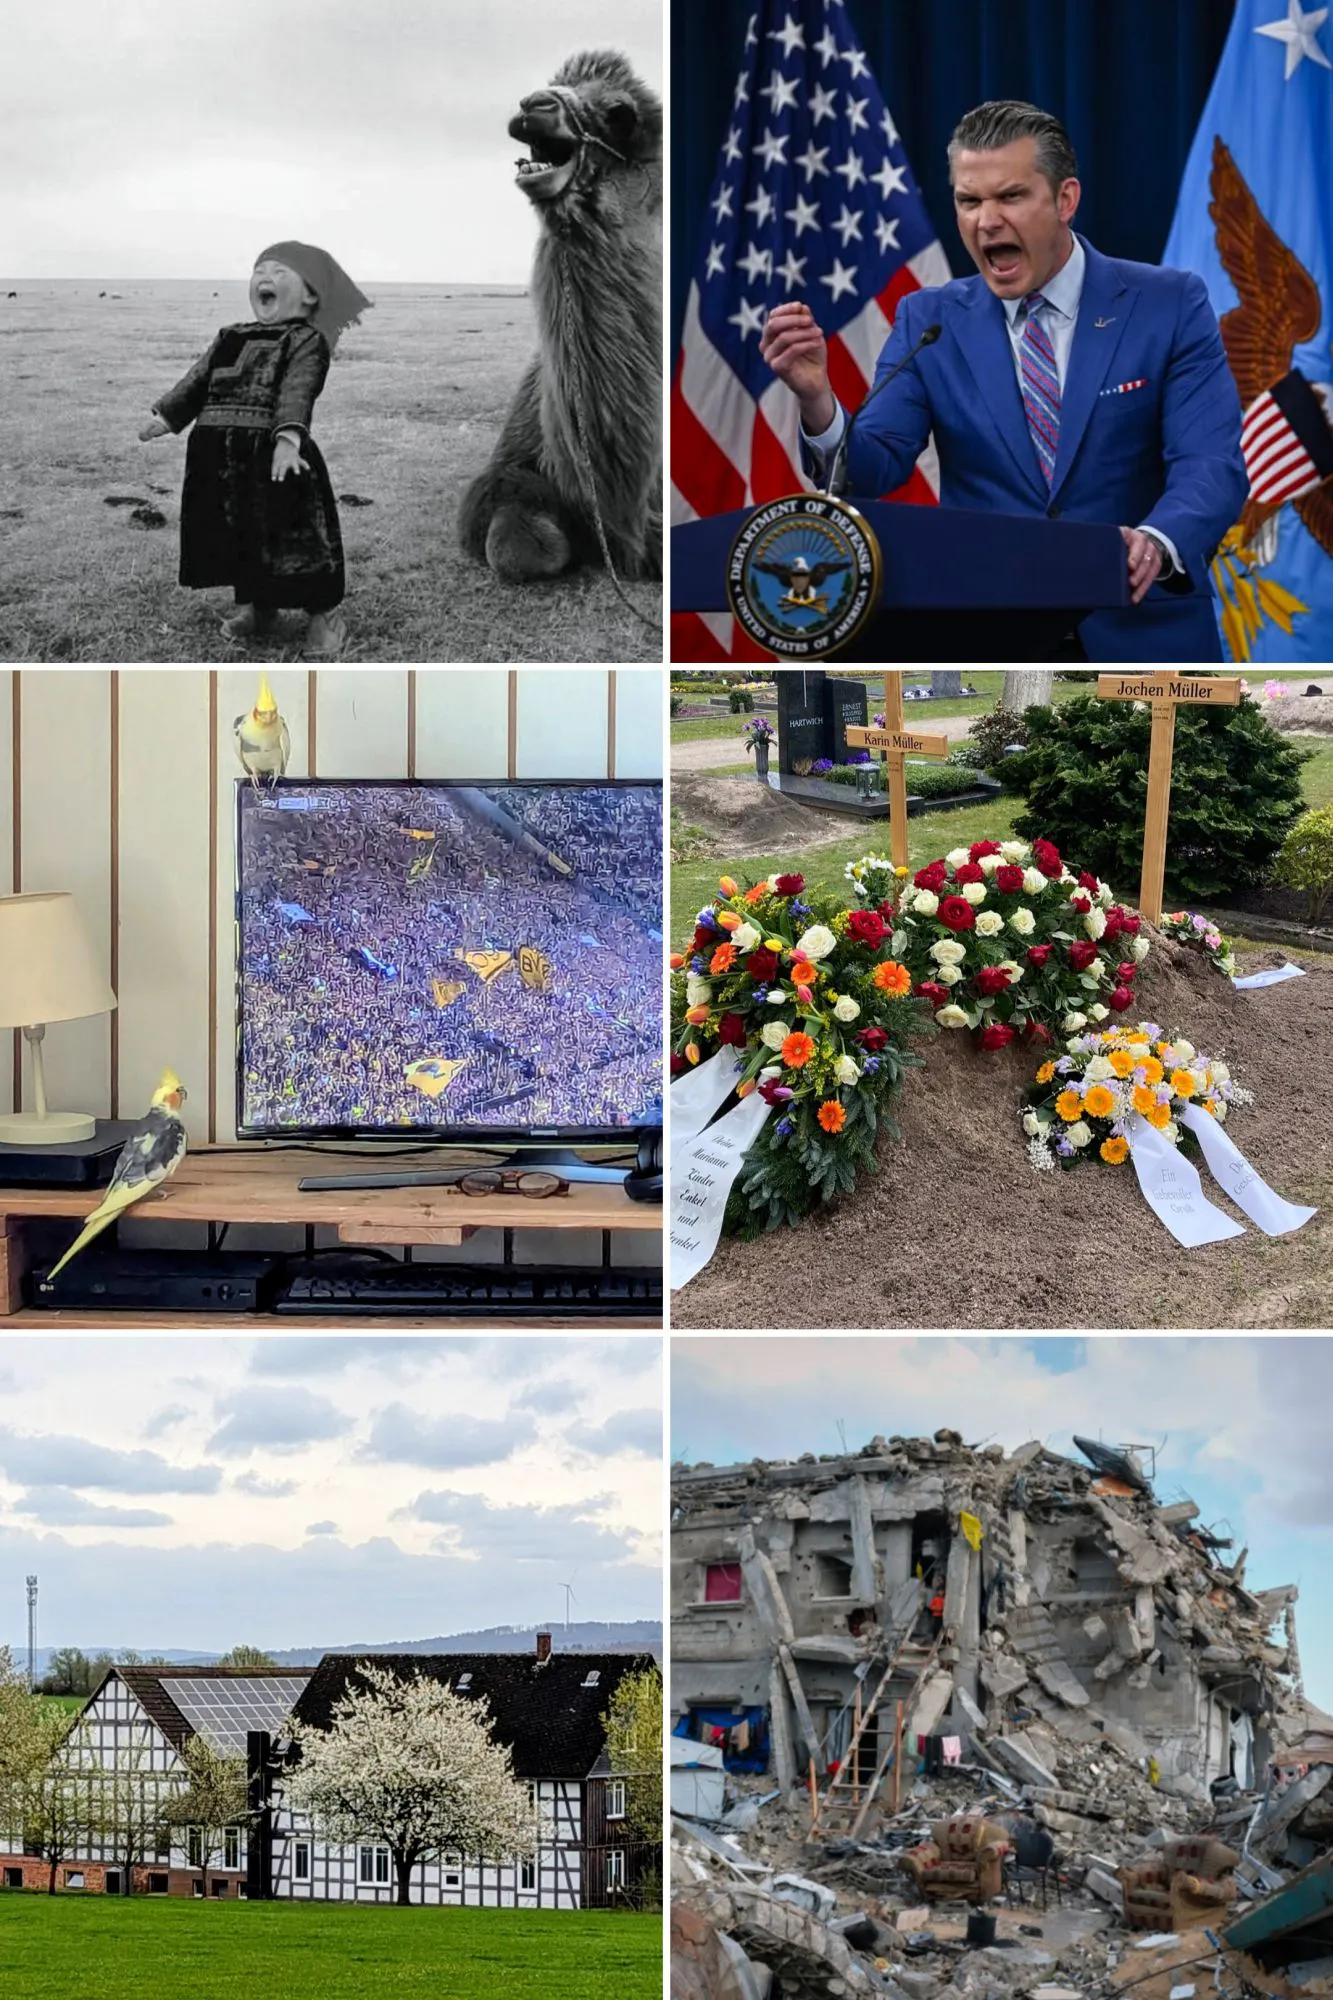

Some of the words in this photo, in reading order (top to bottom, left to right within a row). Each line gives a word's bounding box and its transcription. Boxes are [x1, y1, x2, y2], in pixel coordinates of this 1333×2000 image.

[730, 500, 799, 580] DEPARTMENT
[805, 500, 826, 514] OF
[830, 510, 872, 573] DEFENSE
[737, 596, 766, 637] UNITED
[769, 637, 808, 653] STATES
[814, 636, 829, 649] OF
[834, 591, 867, 639] AMERICA
[1117, 680, 1164, 697] Jochen
[1168, 682, 1213, 699] Müller
[789, 717, 824, 728] HARTWICH
[864, 733, 890, 747] Karin
[892, 736, 923, 751] Müller
[679, 1189, 707, 1206] Enkel
[677, 1215, 700, 1228] und
